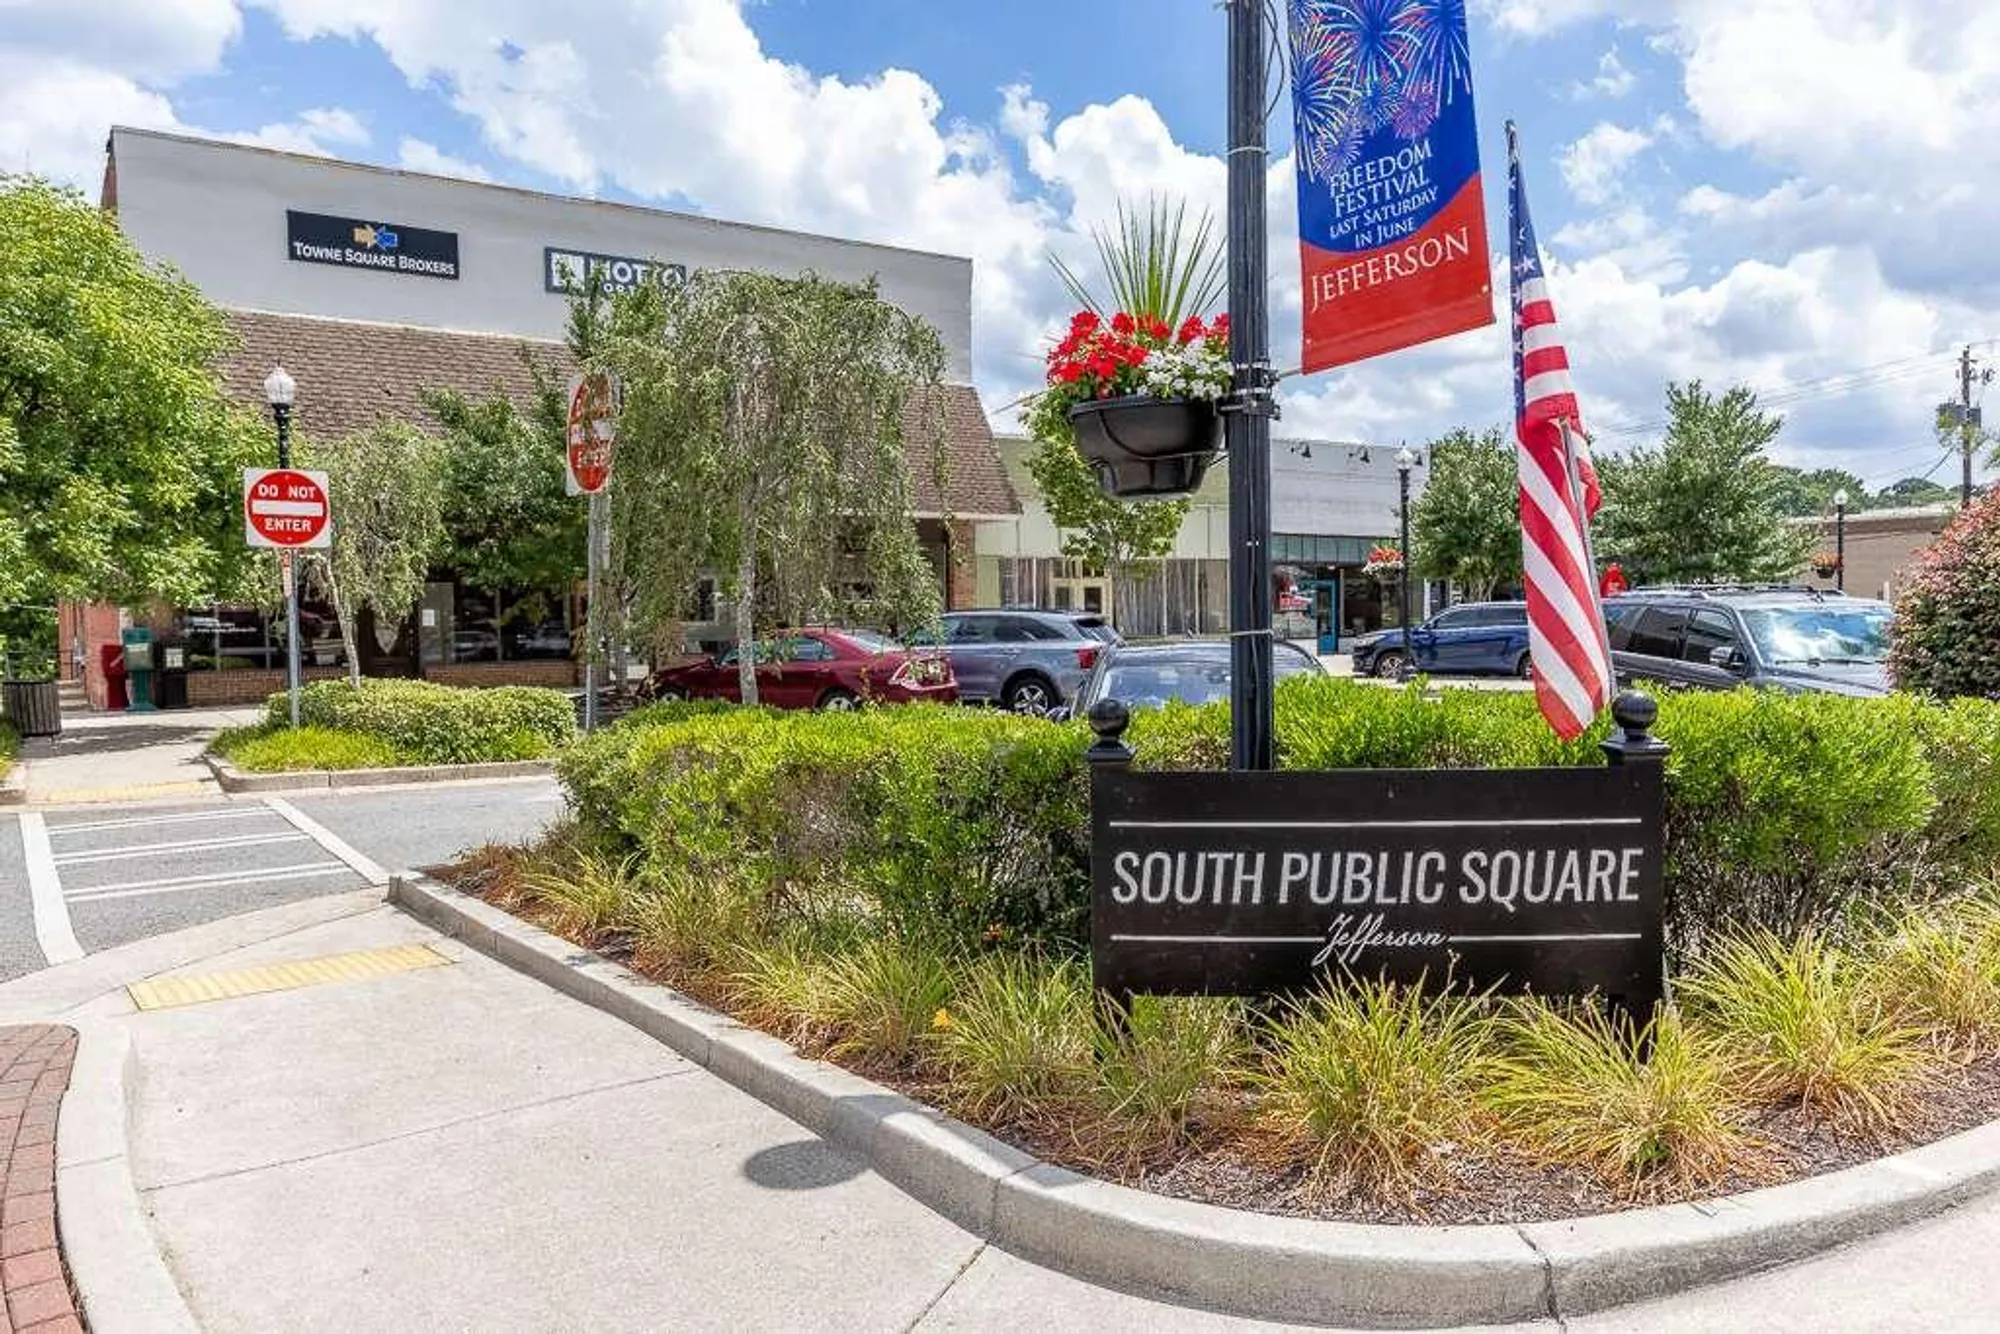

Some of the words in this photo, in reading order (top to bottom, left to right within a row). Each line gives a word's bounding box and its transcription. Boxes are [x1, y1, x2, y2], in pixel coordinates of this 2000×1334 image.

[1330, 139, 1433, 197] FREEDOM
[1335, 165, 1430, 218] FESTIVAL
[1329, 215, 1360, 239] LAST
[1363, 186, 1439, 226] SATURDAY
[1355, 231, 1373, 249] IN
[1377, 216, 1416, 244] JUNE
[293, 241, 343, 262] TOWNE
[345, 249, 396, 268] SQUARE
[399, 255, 455, 276] BROKERS
[589, 256, 683, 289] OTO
[1311, 226, 1470, 314] JEFFERSON
[258, 484, 279, 497] DO
[288, 485, 317, 499] NOT
[264, 517, 312, 532] ENTER
[1111, 851, 1265, 904] SOUTH
[1279, 851, 1447, 904] PUBLIC
[1458, 848, 1644, 912] SQUARE
[1311, 912, 1447, 967] Jefferson
